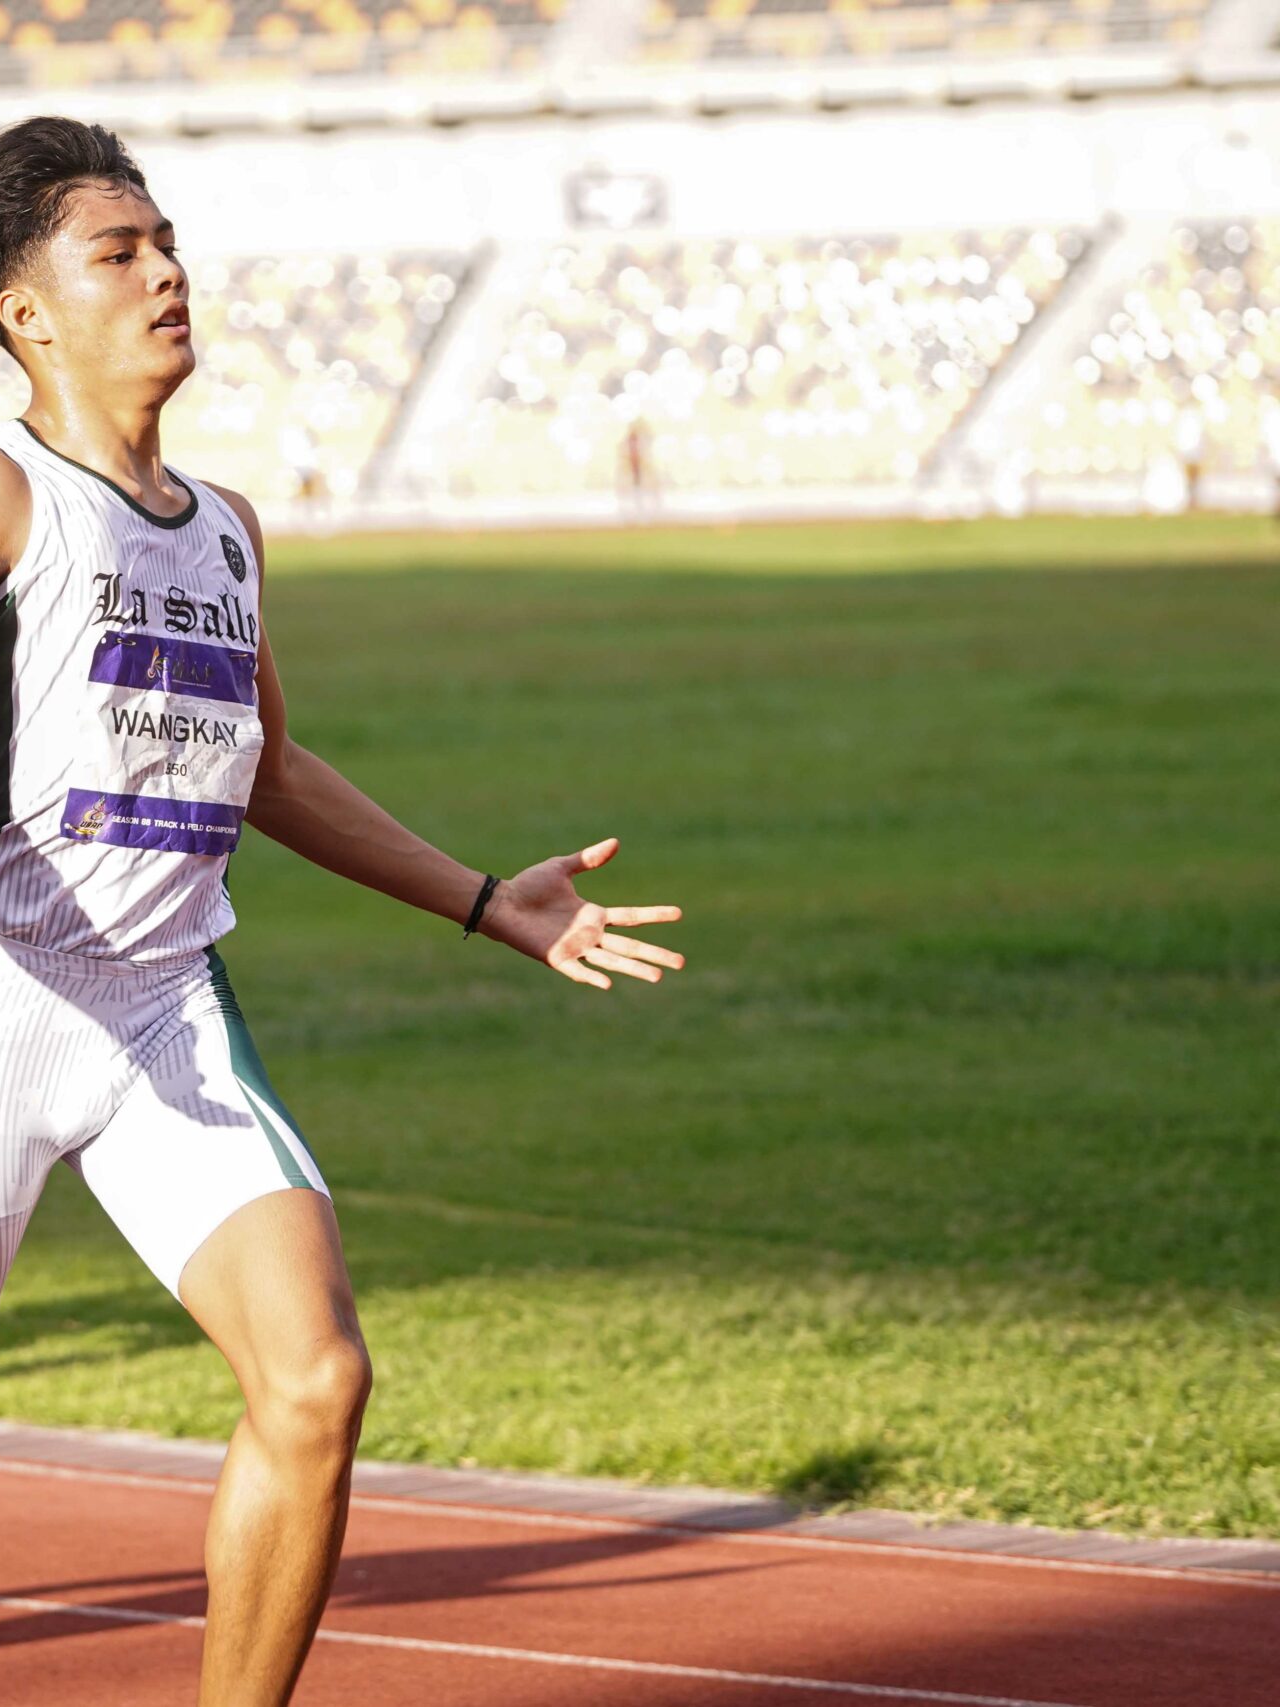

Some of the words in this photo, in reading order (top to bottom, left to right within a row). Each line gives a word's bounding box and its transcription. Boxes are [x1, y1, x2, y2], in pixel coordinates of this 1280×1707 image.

[92, 572, 149, 626] La
[163, 585, 258, 648] Salle
[112, 707, 238, 748] WANGKAY
[111, 815, 139, 825] SEASON
[154, 819, 179, 830] TRACK
[179, 822, 186, 830] &
[187, 823, 205, 832] FIELD
